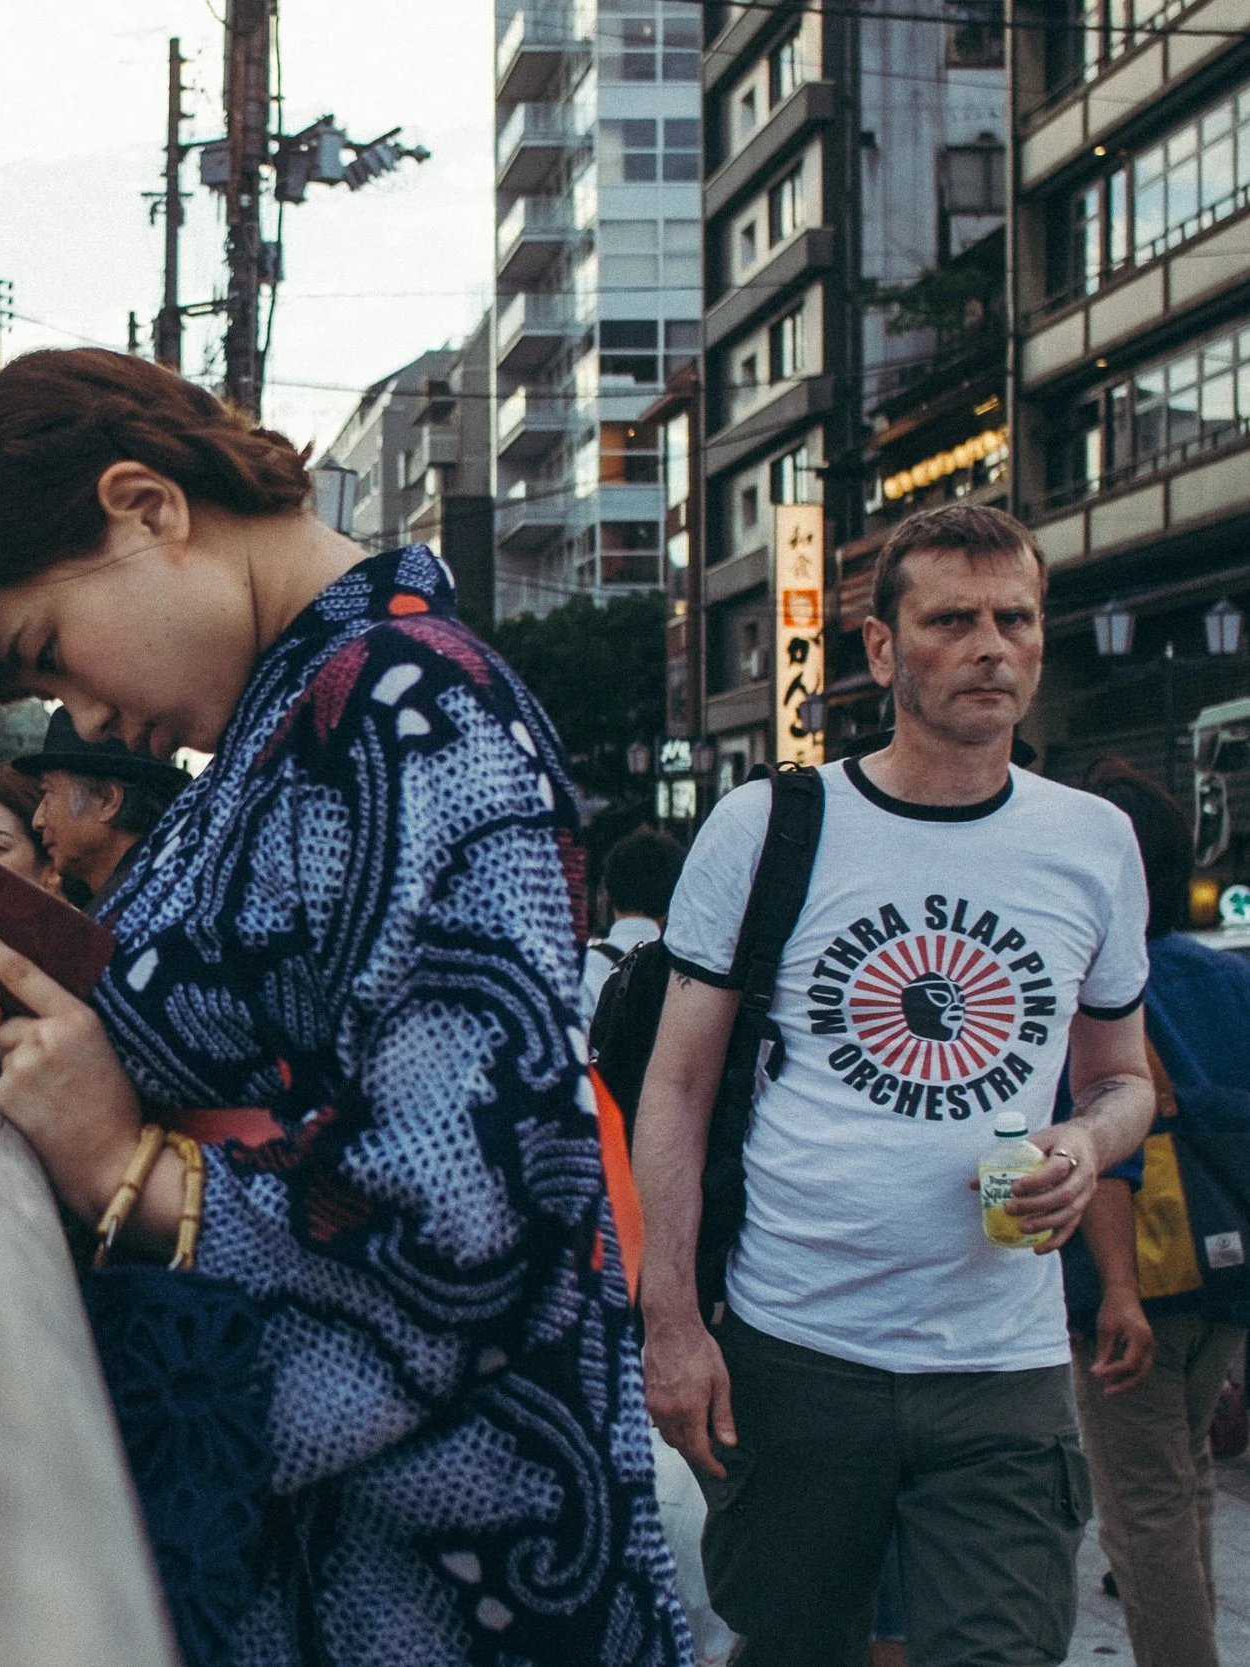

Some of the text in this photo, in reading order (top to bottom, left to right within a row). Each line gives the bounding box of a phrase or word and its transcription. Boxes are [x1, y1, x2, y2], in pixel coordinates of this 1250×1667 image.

[807, 894, 1057, 1047] MOTHRA SLAPPING
[828, 1043, 1034, 1121] ORCHESTRA
